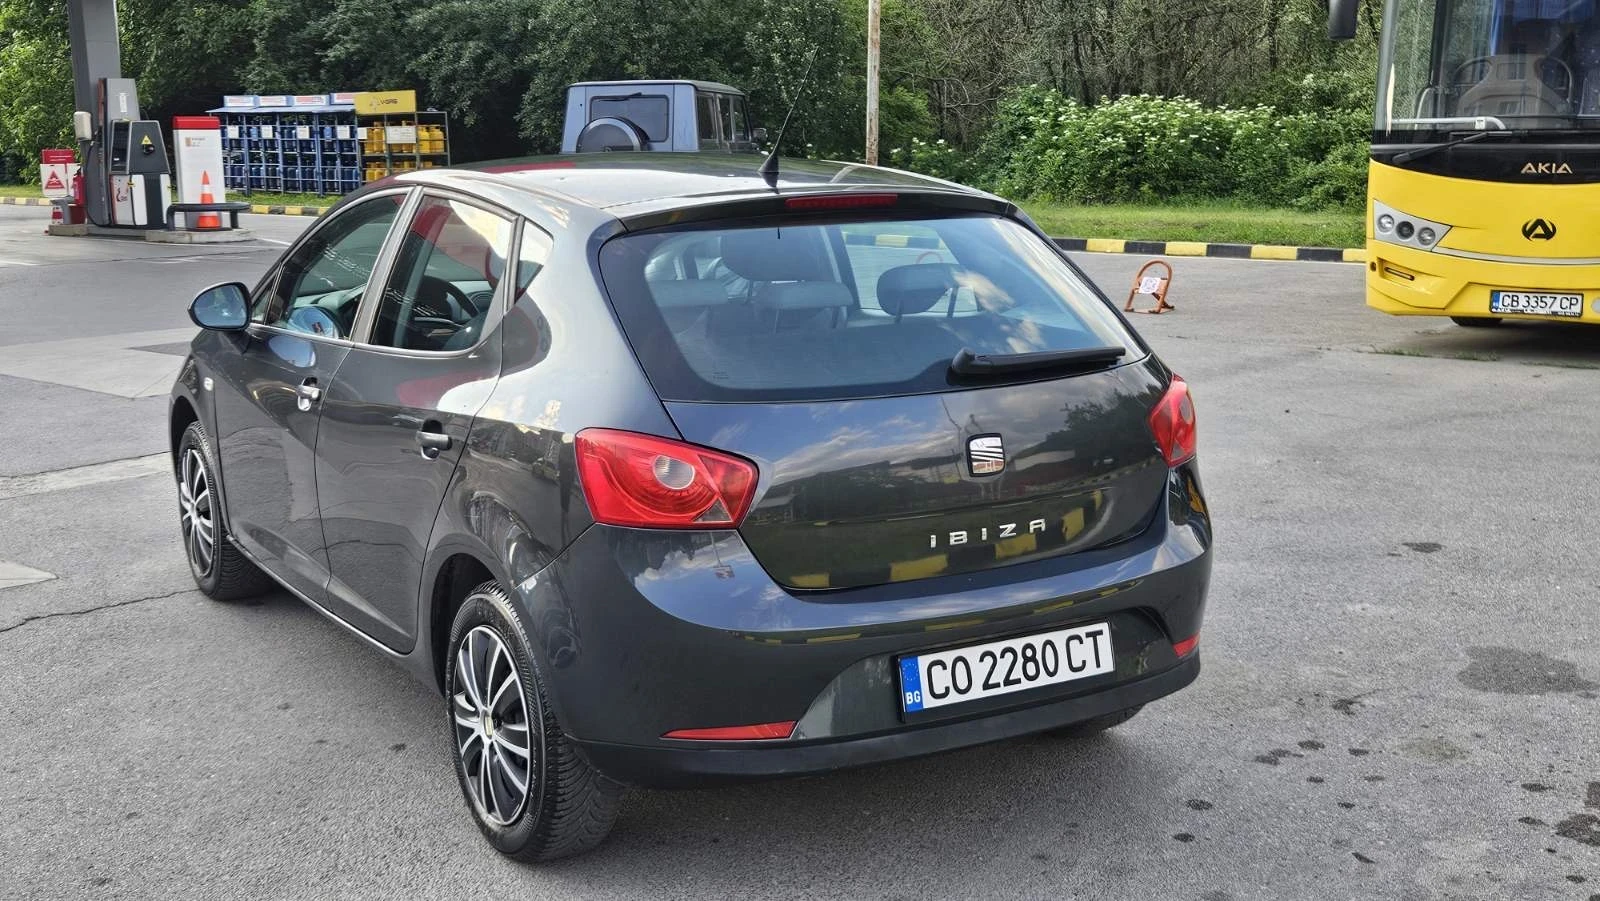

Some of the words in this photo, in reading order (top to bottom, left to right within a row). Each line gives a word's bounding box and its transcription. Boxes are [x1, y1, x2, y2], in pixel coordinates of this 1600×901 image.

[1521, 162, 1573, 174] AKIA
[1502, 294, 1520, 308] CB
[1522, 295, 1557, 309] 3357
[1560, 296, 1579, 310] CP
[926, 655, 973, 700] CO
[978, 639, 1060, 692] 2280
[1065, 629, 1104, 673] CT
[906, 692, 921, 705] BG
